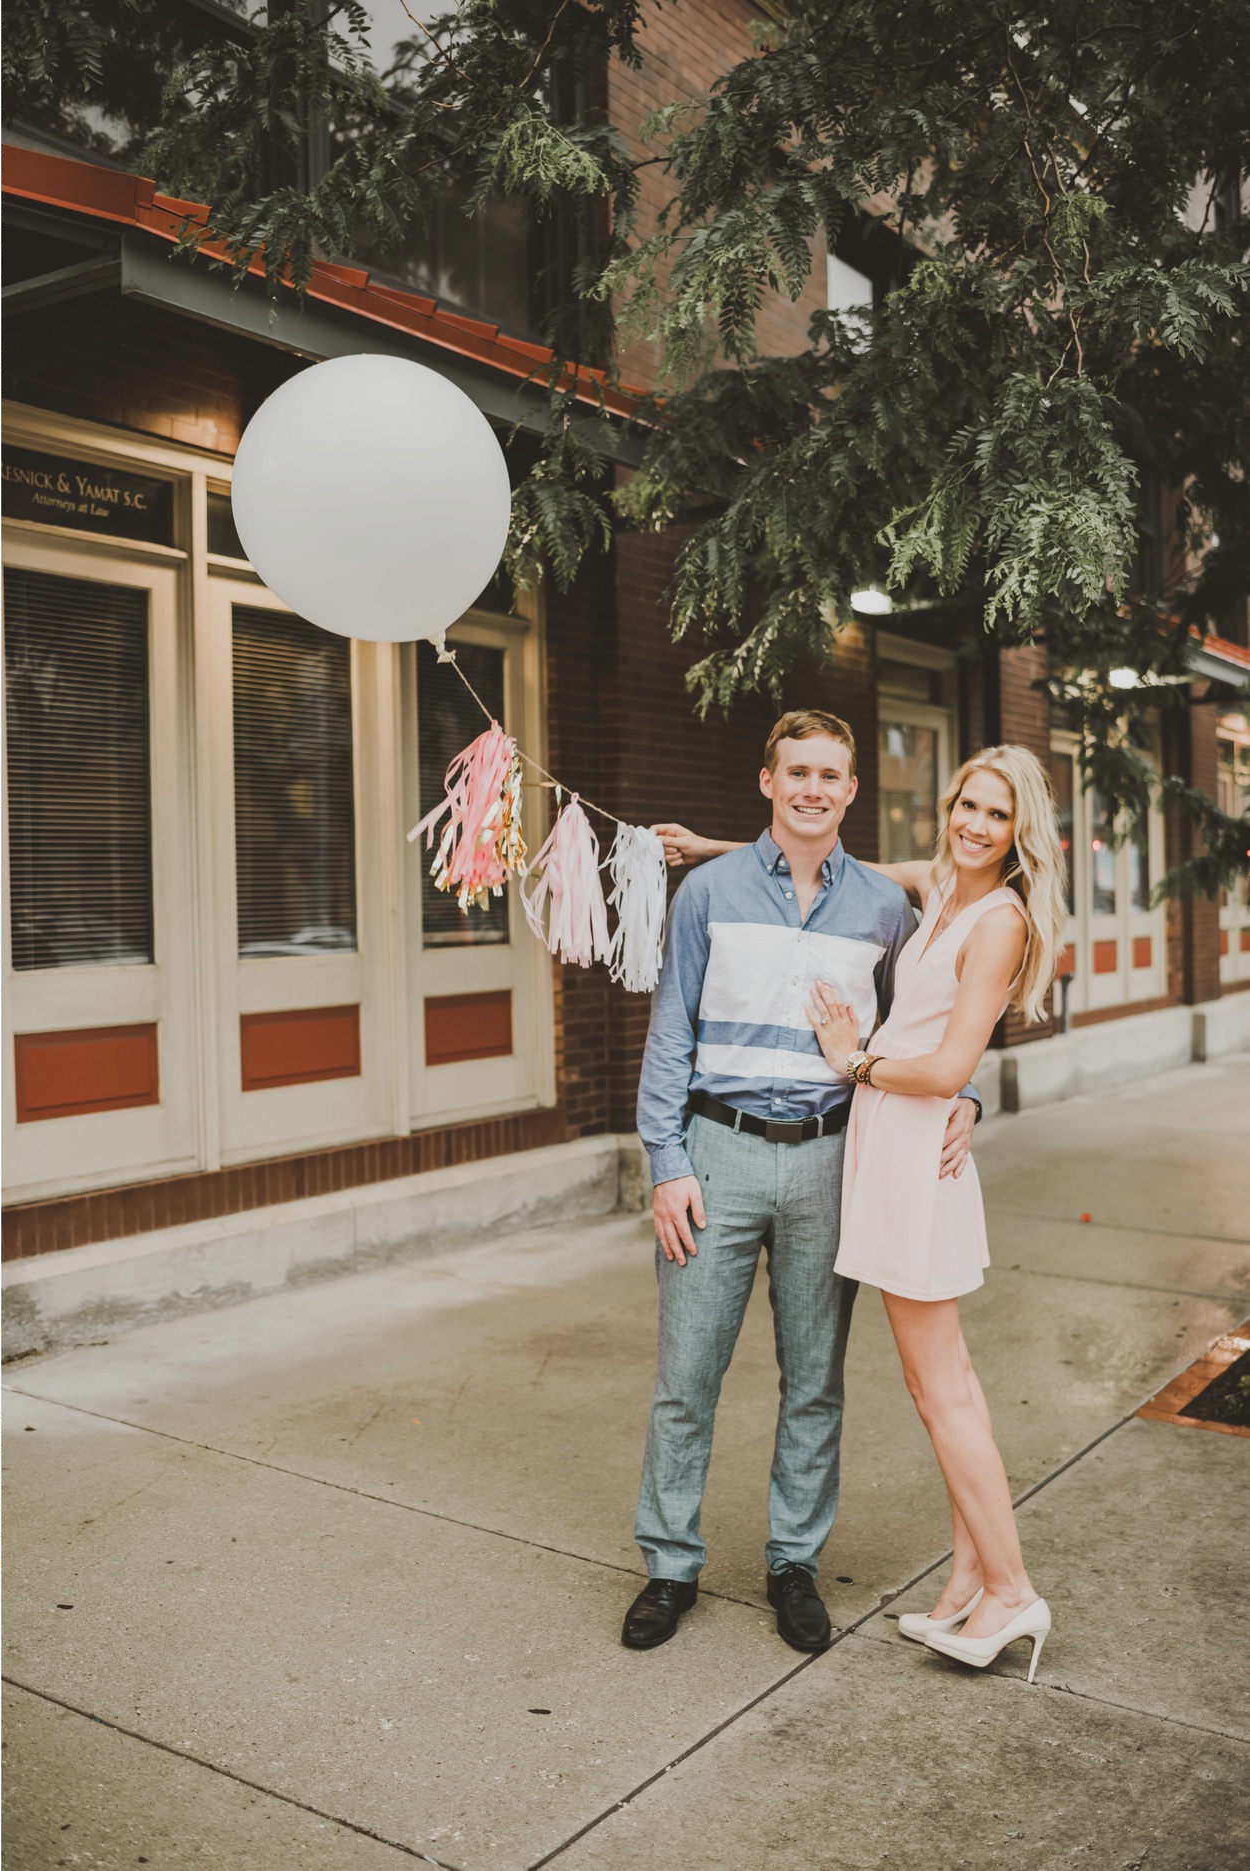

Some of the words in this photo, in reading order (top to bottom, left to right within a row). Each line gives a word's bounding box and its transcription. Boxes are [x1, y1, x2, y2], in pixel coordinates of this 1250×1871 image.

[32, 492, 75, 513] Attorneys
[78, 503, 88, 514] at
[90, 503, 111, 517] Law
[57, 472, 72, 494] &
[75, 476, 120, 504] YAMAT
[124, 491, 147, 510] S.C.
